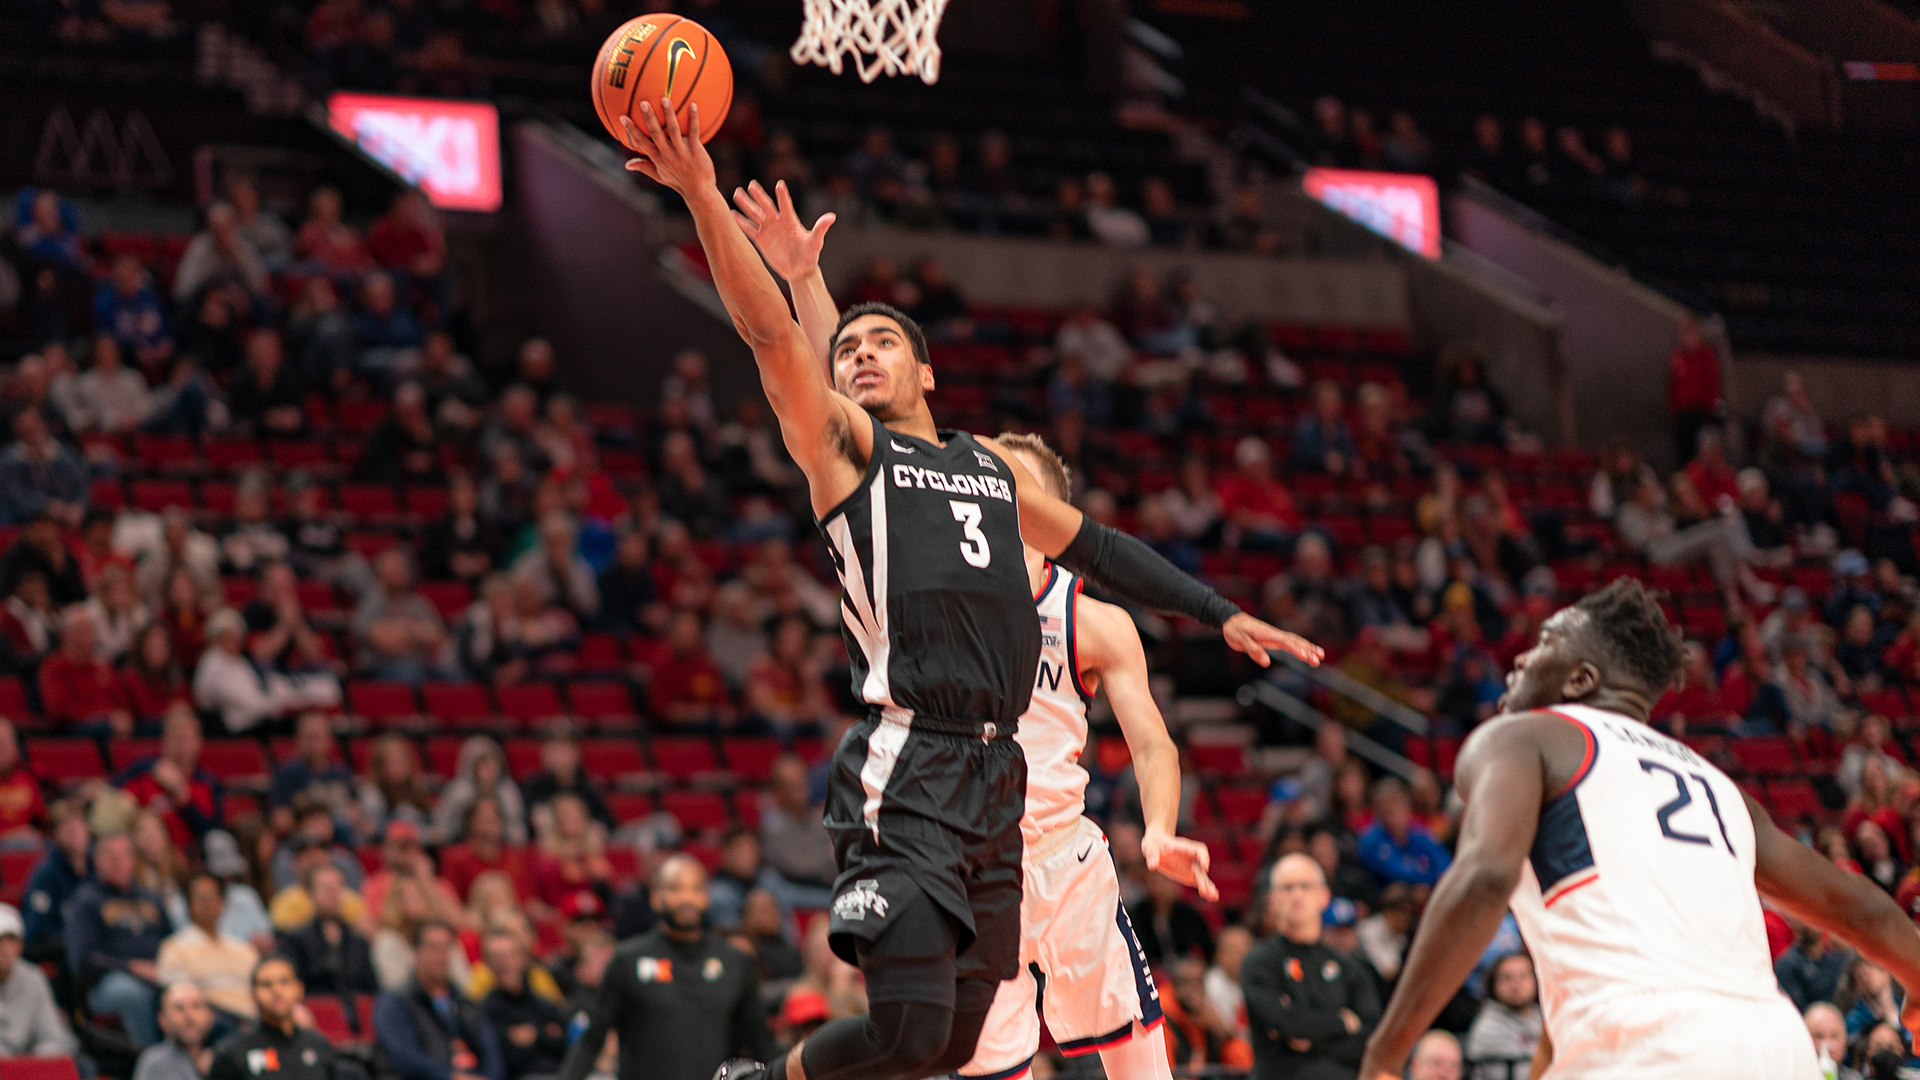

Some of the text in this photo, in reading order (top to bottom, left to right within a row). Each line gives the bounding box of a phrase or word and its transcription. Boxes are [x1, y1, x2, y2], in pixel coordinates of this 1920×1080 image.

[892, 464, 1013, 503] CYCLONES
[949, 500, 991, 569] 3
[1638, 758, 1738, 858] 21
